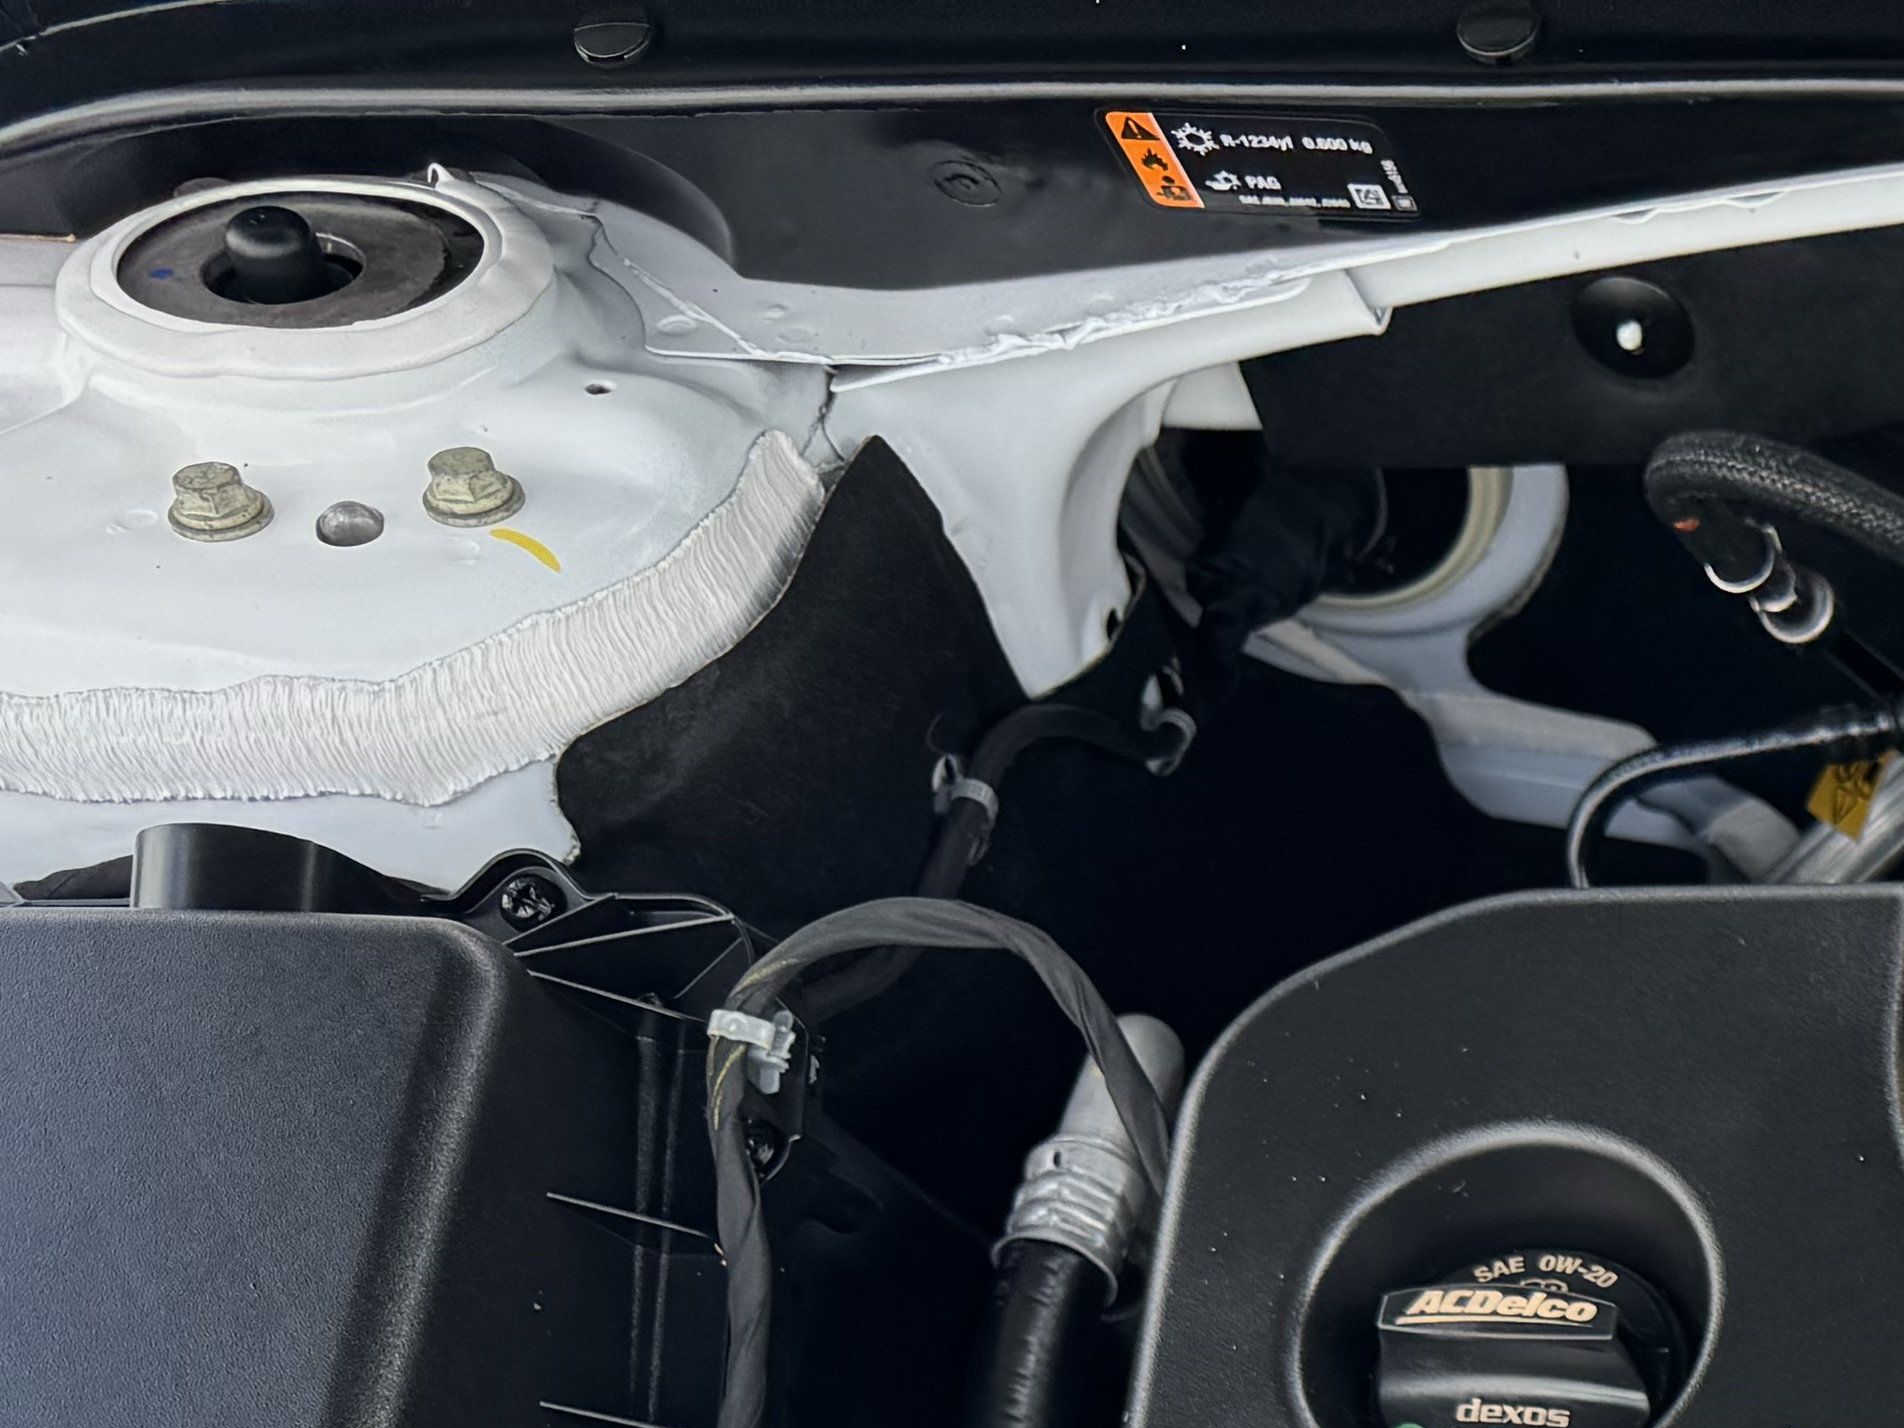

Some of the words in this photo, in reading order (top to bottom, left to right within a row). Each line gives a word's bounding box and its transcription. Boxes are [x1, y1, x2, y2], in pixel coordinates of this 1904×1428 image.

[1473, 1256, 1525, 1284] SAE
[1539, 1254, 1619, 1289] 0W-20
[1406, 1289, 1598, 1323] ACDelco
[1456, 1398, 1571, 1428] dexos
